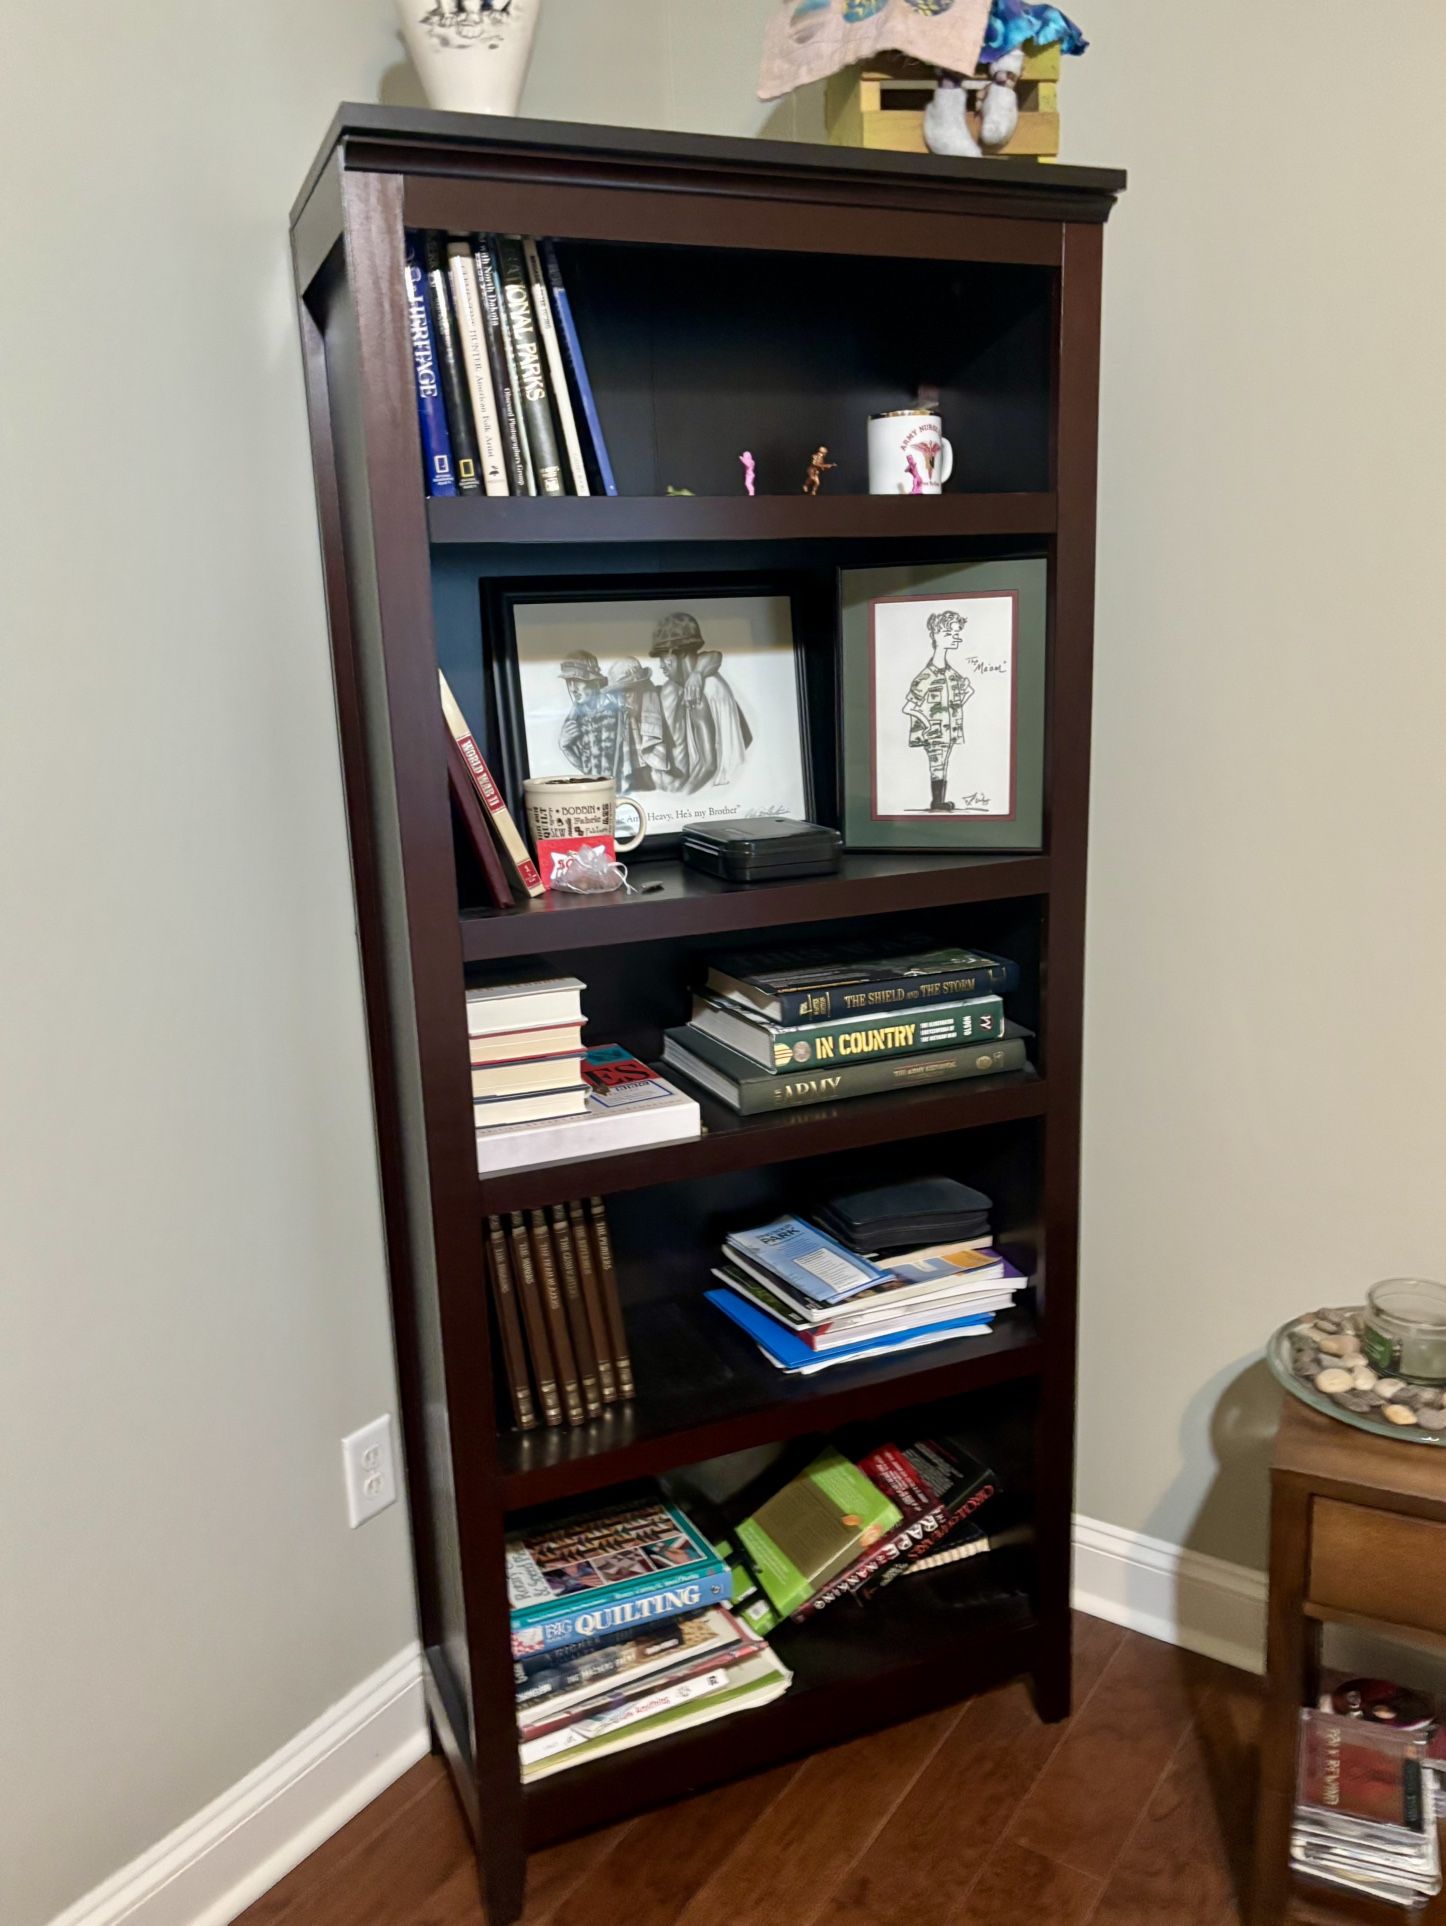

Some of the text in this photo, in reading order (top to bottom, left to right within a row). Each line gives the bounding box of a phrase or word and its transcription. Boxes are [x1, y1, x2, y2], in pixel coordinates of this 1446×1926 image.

[483, 266, 496, 292] North
[486, 294, 499, 326] Dakota
[409, 296, 437, 398] HERITAGE
[516, 342, 546, 401] PARKS
[475, 376, 488, 413] American
[481, 415, 491, 433] Folk
[900, 428, 918, 451] ARMY
[484, 437, 495, 457] Artist
[461, 740, 483, 776] WORLD
[476, 773, 494, 797] WAR
[562, 805, 596, 816] BOBBIN
[675, 809, 693, 819] He's
[694, 810, 706, 819] my
[844, 994, 866, 1009] THE
[867, 988, 905, 1006] SHIELD
[920, 983, 941, 998] THE
[942, 977, 976, 994] STORM
[815, 1023, 916, 1059] IN COUNTRY
[784, 1076, 841, 1097] ARMY
[760, 1227, 800, 1246] PARK
[882, 1515, 939, 1560] RAPE
[813, 1562, 878, 1609] NANKING
[575, 1584, 701, 1636] QUILTING
